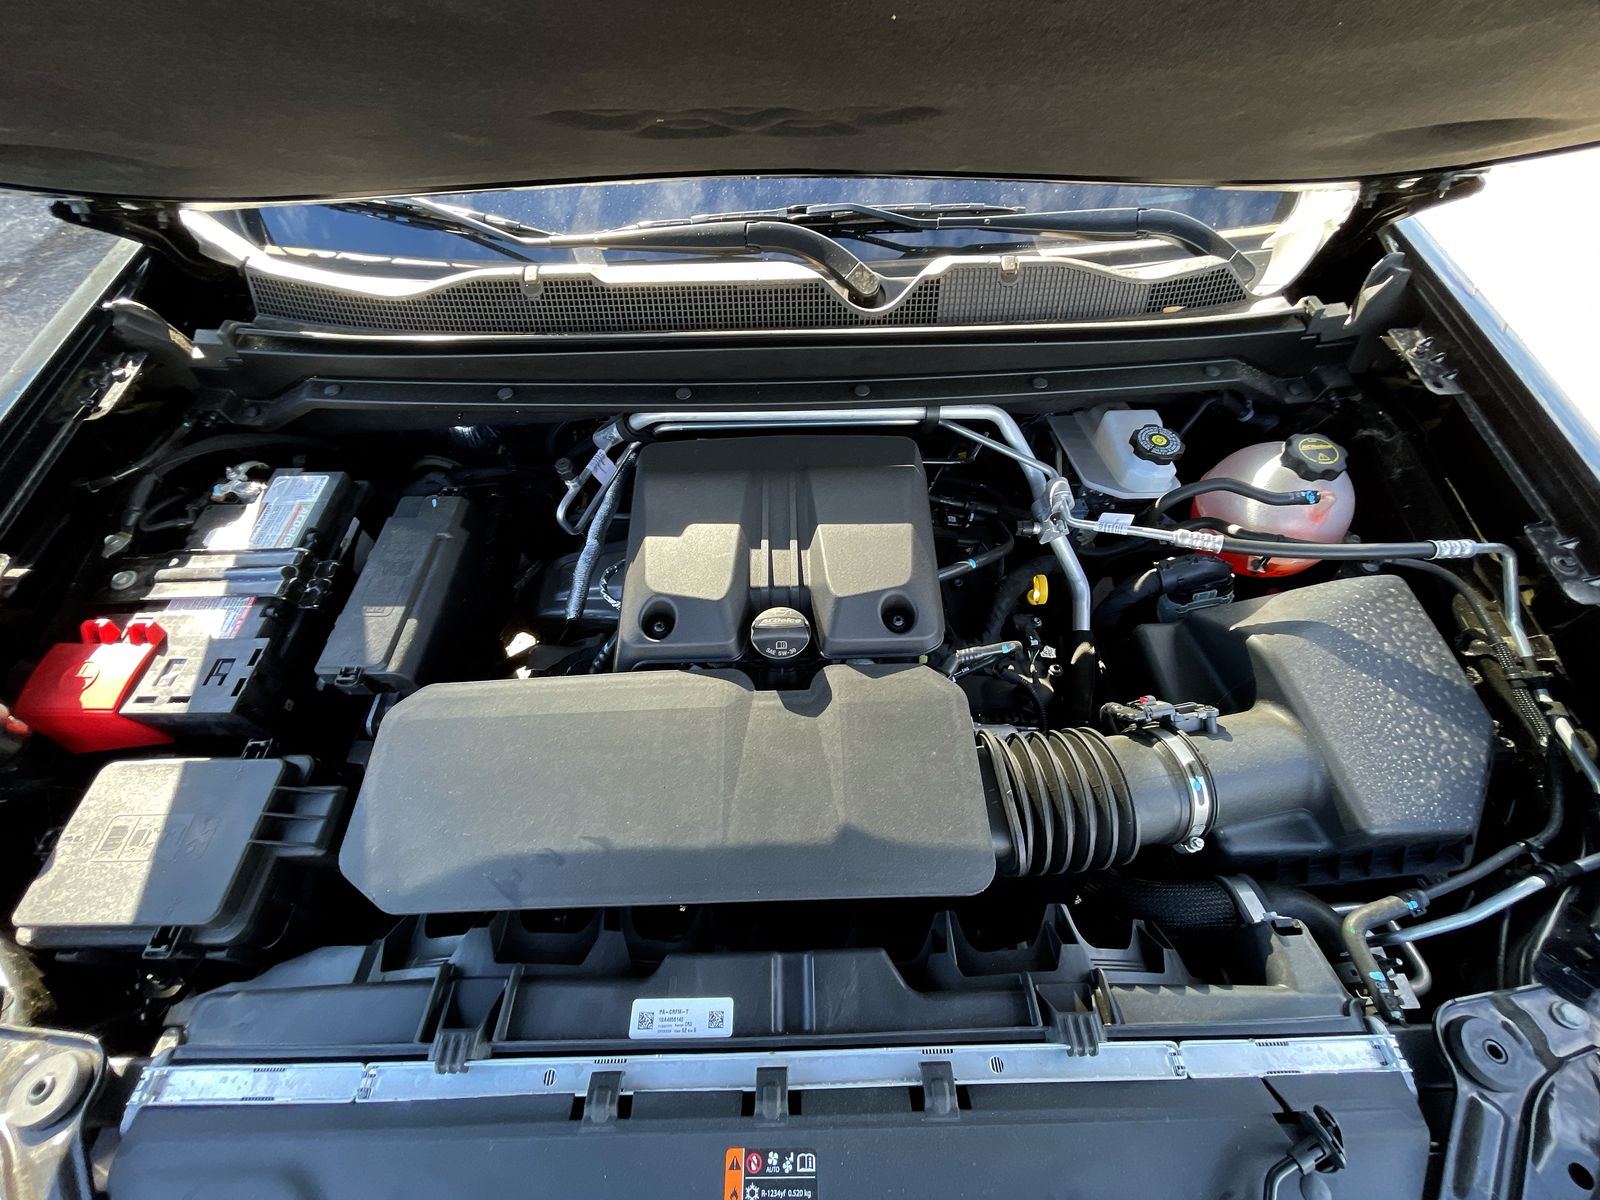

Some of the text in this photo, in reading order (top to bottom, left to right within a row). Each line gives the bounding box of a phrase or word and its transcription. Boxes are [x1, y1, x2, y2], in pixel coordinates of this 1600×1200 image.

[765, 647, 797, 657] SAE 5W-30
[765, 1166, 781, 1174] AUTO
[761, 1189, 812, 1199] R-1234yf 0.520 kg
